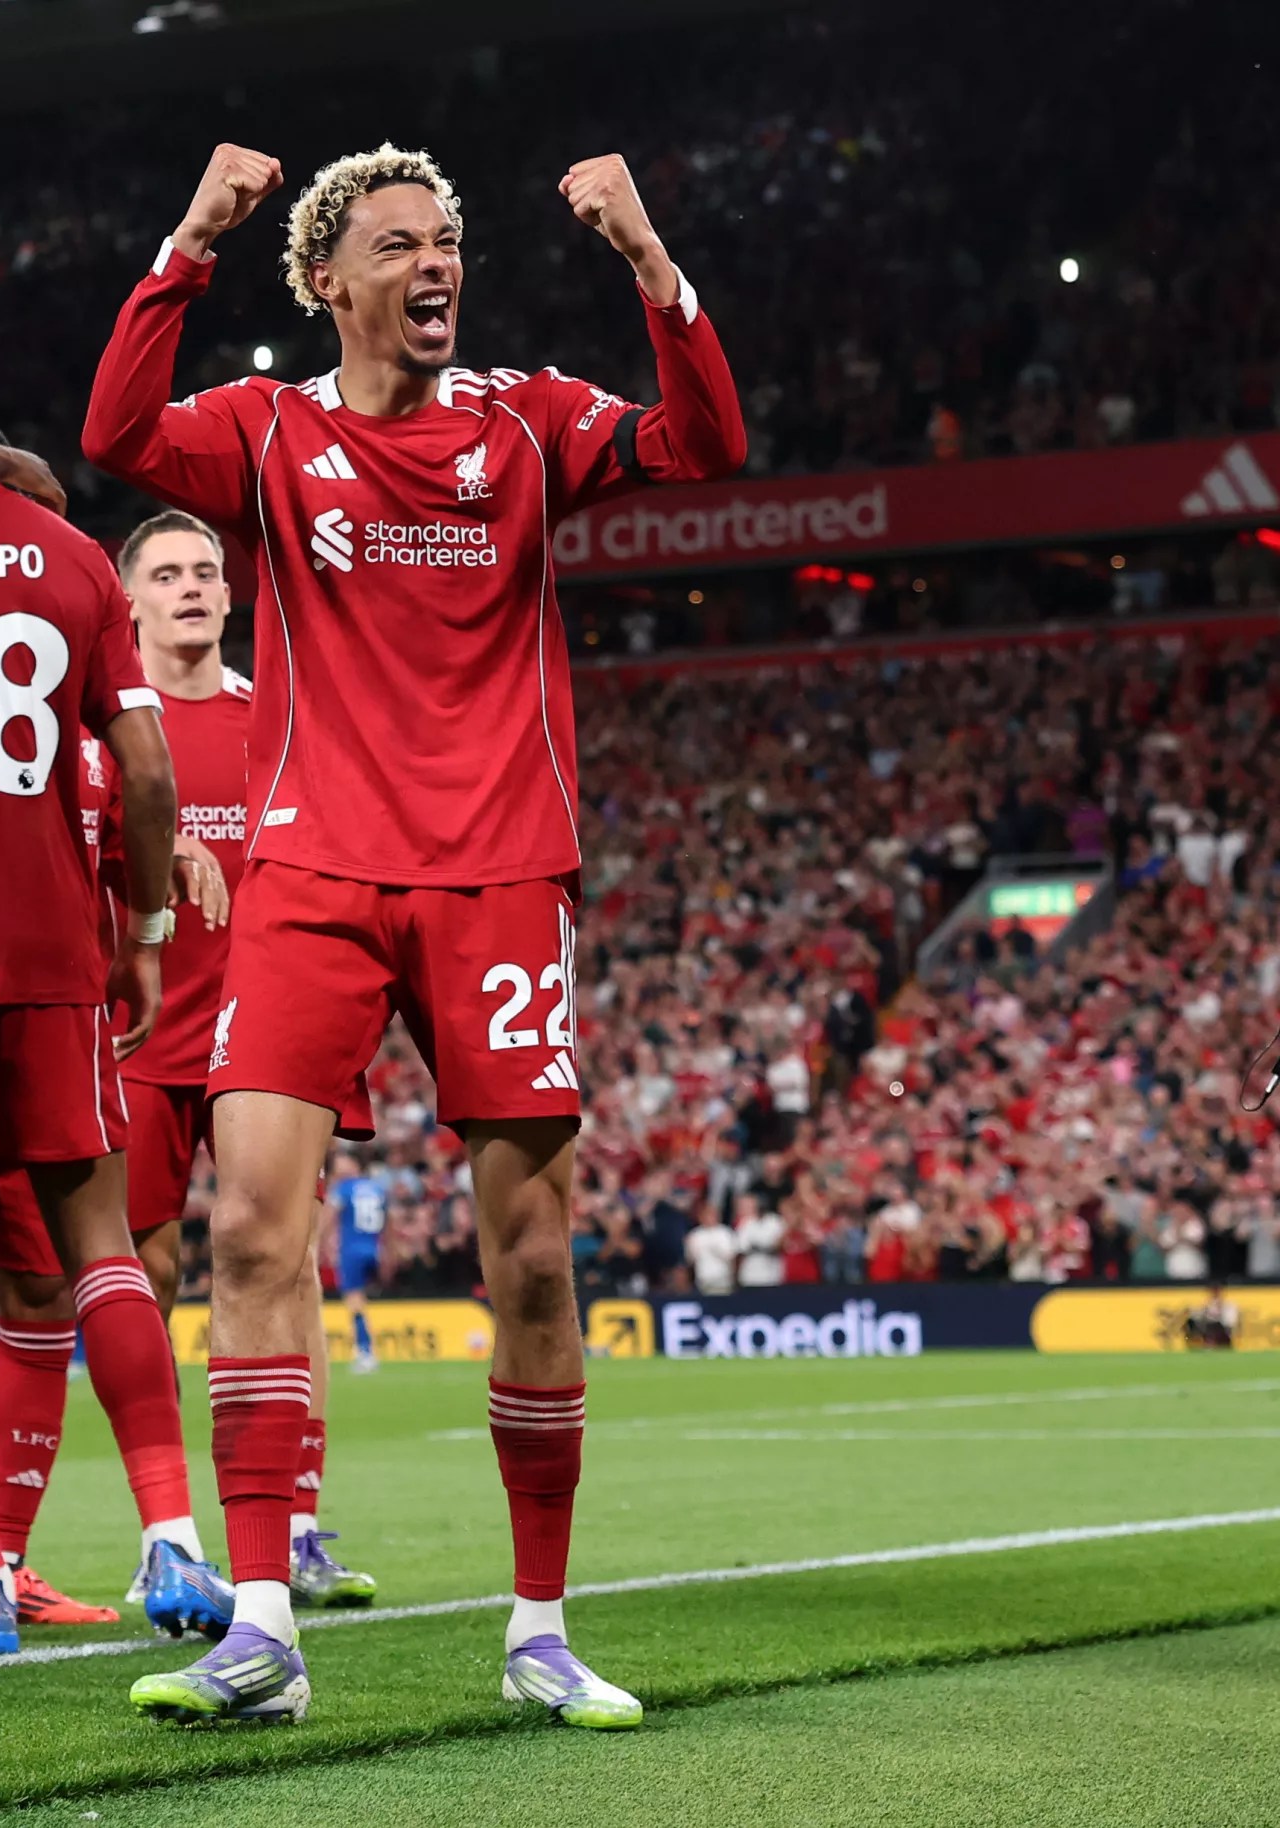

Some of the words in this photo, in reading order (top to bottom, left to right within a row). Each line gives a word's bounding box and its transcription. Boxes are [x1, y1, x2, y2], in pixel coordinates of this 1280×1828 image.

[364, 520, 488, 545] standard
[601, 486, 888, 556] chartered
[363, 543, 498, 567] chartered
[180, 823, 245, 841] charte
[481, 963, 574, 1051] 22
[663, 1299, 922, 1358] Expedia
[11, 1428, 58, 1450] LFC
[300, 1435, 325, 1451] FC
